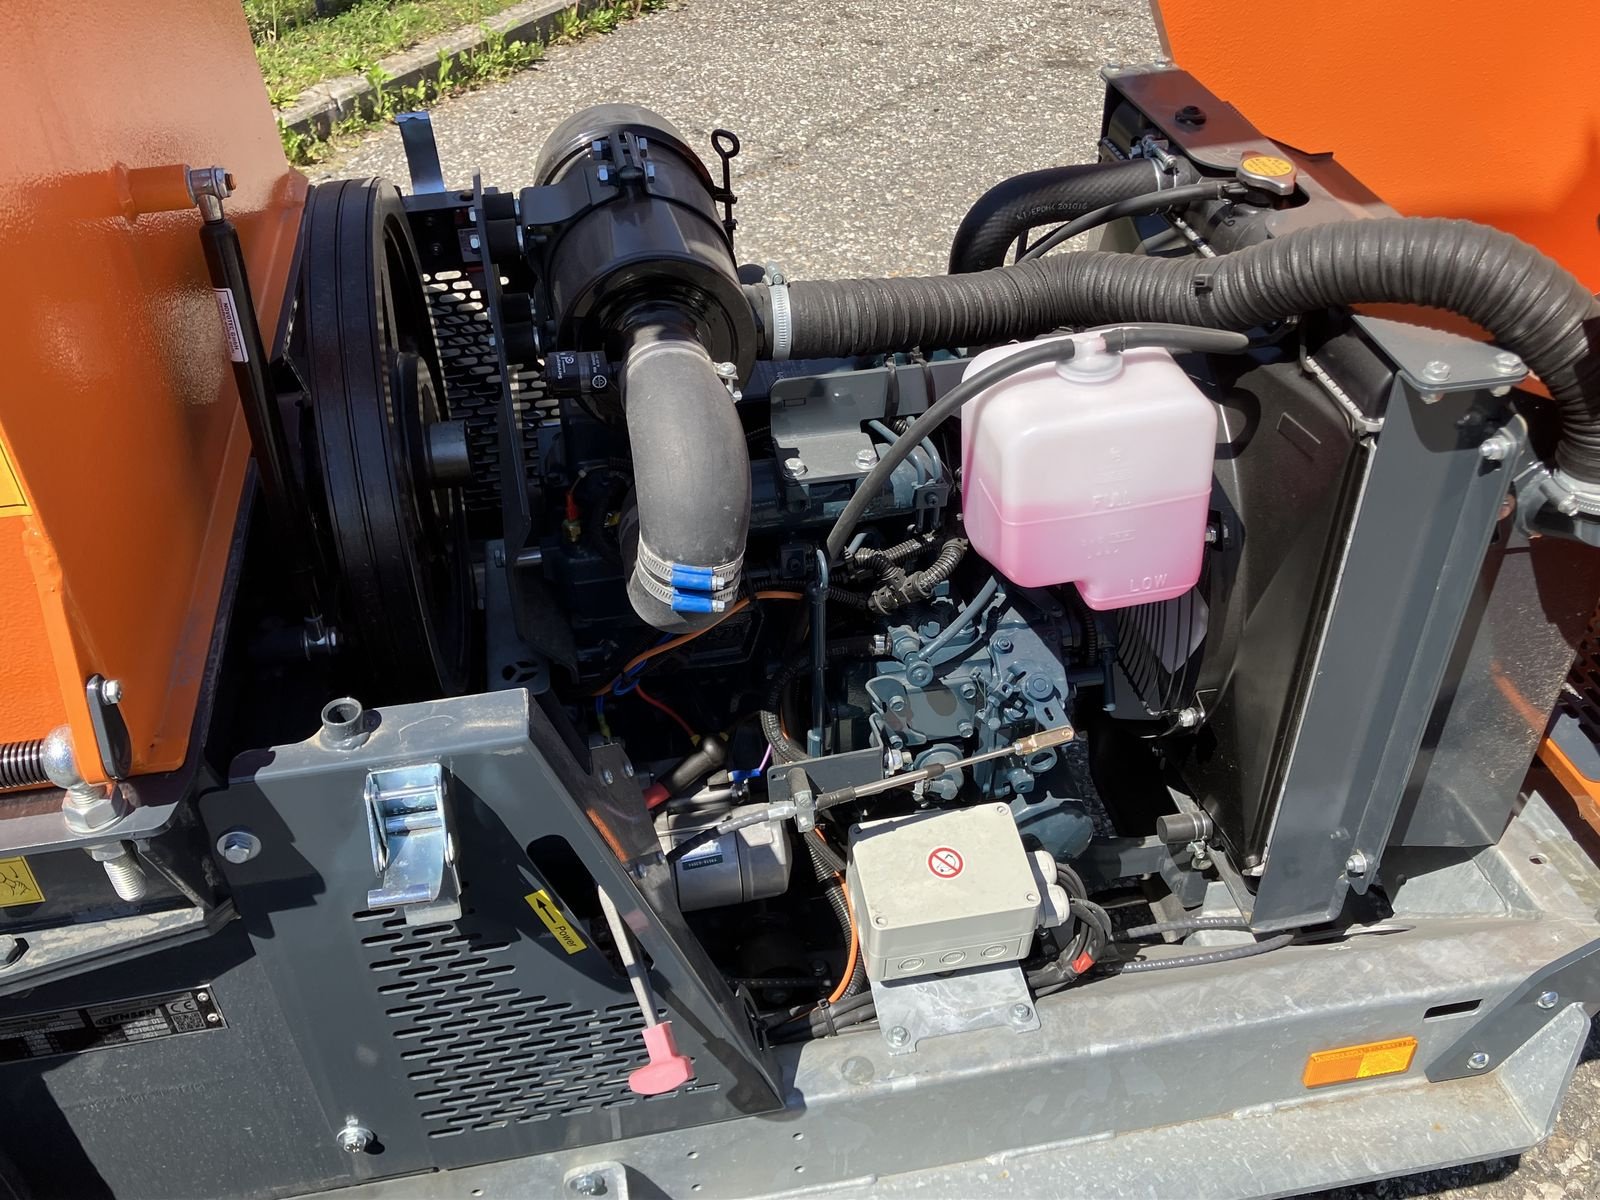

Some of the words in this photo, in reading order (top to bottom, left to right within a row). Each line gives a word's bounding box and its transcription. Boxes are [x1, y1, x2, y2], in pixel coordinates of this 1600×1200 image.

[223, 303, 234, 331] NOVOTEC
[1130, 573, 1168, 593] LOW
[556, 926, 577, 947] Power
